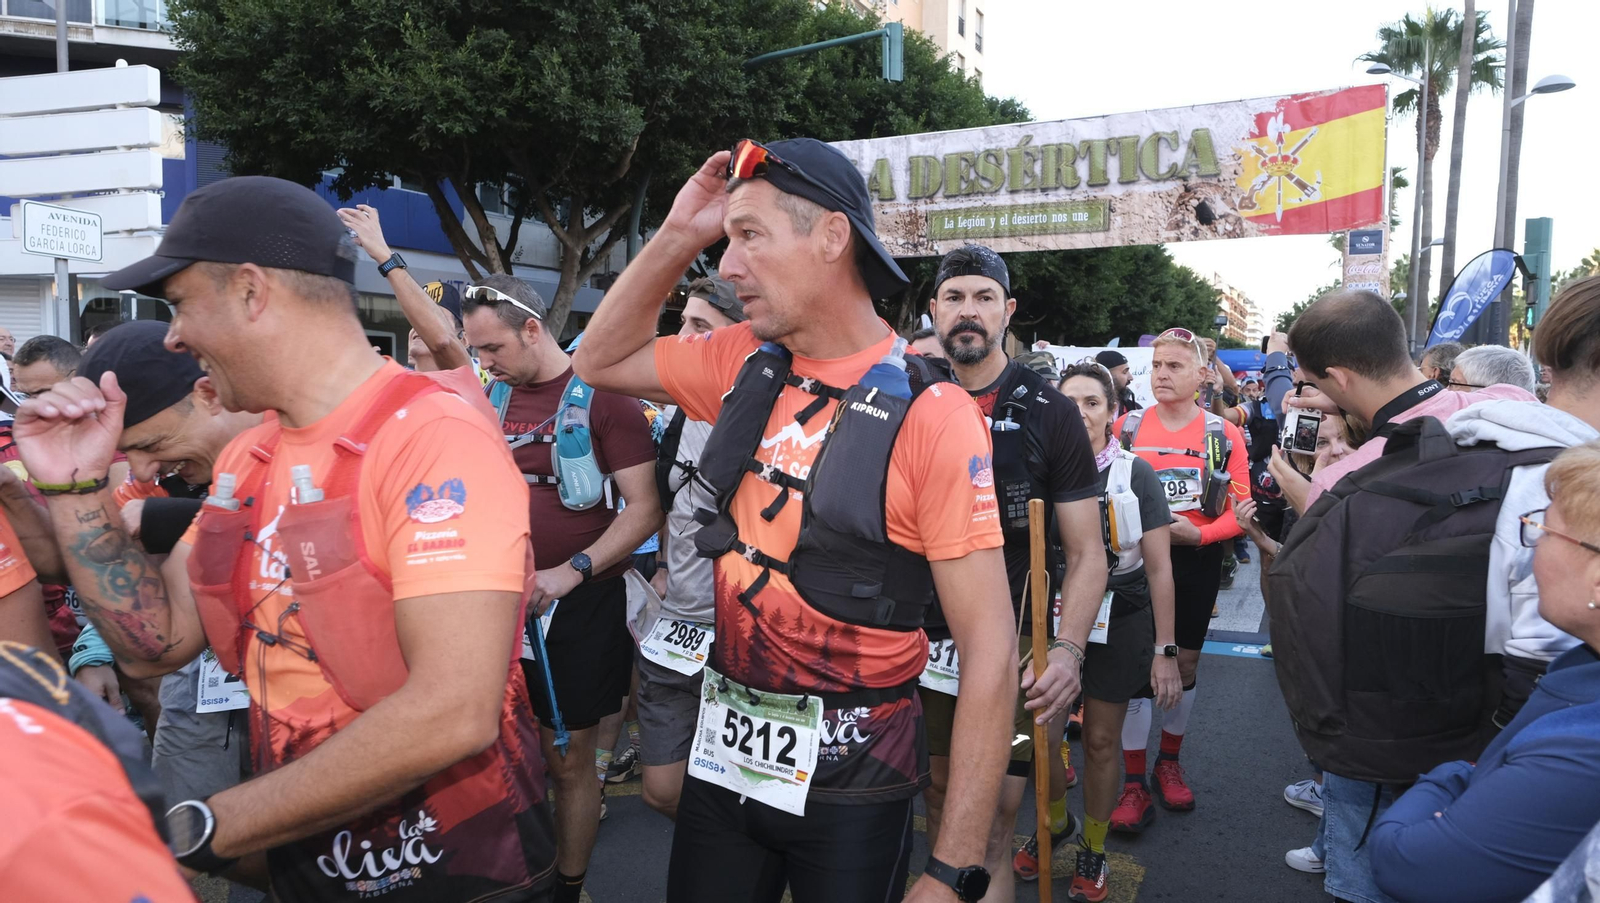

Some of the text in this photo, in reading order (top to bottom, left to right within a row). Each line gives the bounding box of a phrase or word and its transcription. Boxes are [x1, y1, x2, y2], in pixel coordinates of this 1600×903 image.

[908, 127, 1221, 199] DESÉRTICA
[48, 212, 98, 227] AVENIDA
[944, 211, 1089, 229] La Legión y el desierto nos une
[41, 223, 86, 241] FEDERICO
[29, 236, 97, 256] GARCÍA LORCA
[1418, 383, 1439, 397] SONY
[850, 401, 889, 421] KIPRUN
[422, 538, 466, 551] BARRIO
[663, 620, 706, 652] 2989
[722, 707, 798, 768] 5212
[703, 748, 715, 758] BUS
[743, 756, 753, 766] LOS
[359, 879, 414, 899] TABERNA
